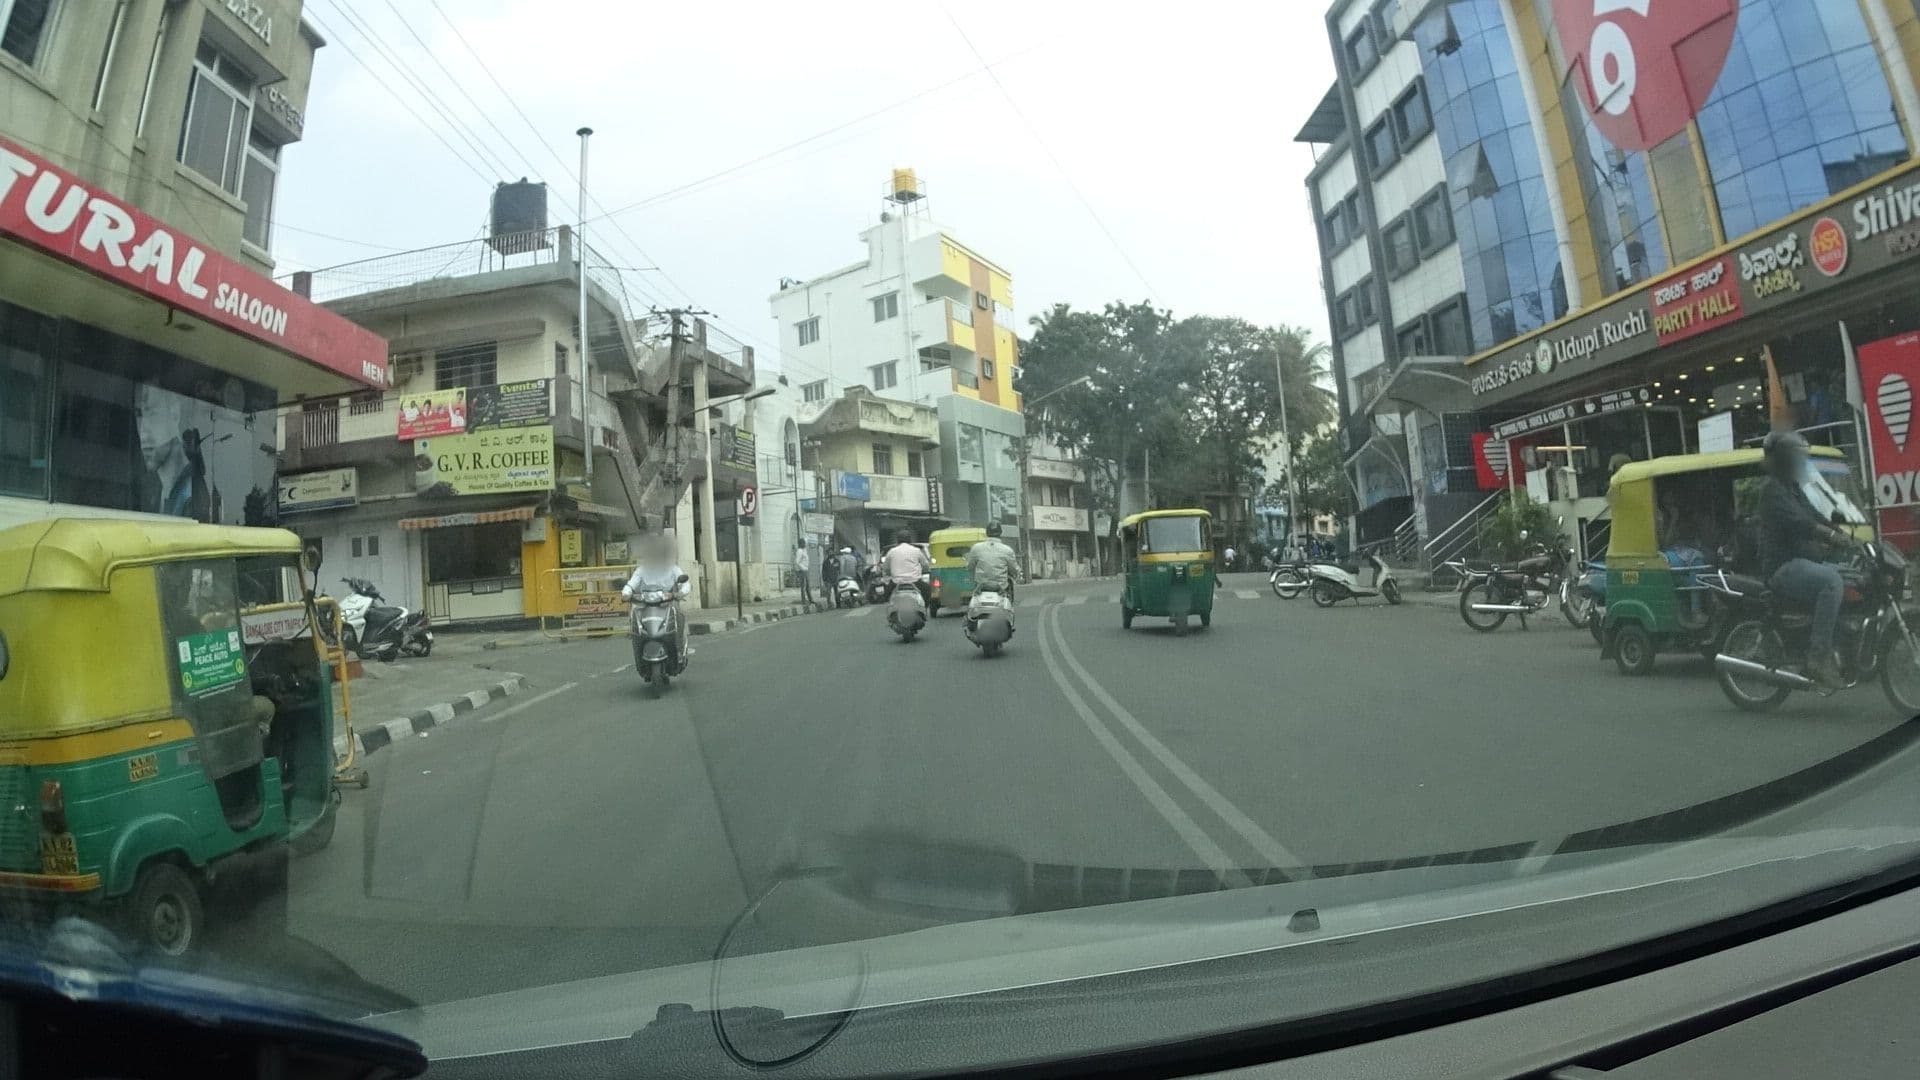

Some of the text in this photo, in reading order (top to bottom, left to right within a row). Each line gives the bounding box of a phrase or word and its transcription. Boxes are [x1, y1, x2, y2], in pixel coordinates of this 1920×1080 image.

[214, 282, 288, 337] SALOON
[1654, 289, 1736, 337] PARTY HALL
[1554, 307, 1648, 364] Udupi Ruchi
[362, 359, 384, 384] MEN
[194, 650, 228, 666] PEACE AUTO
